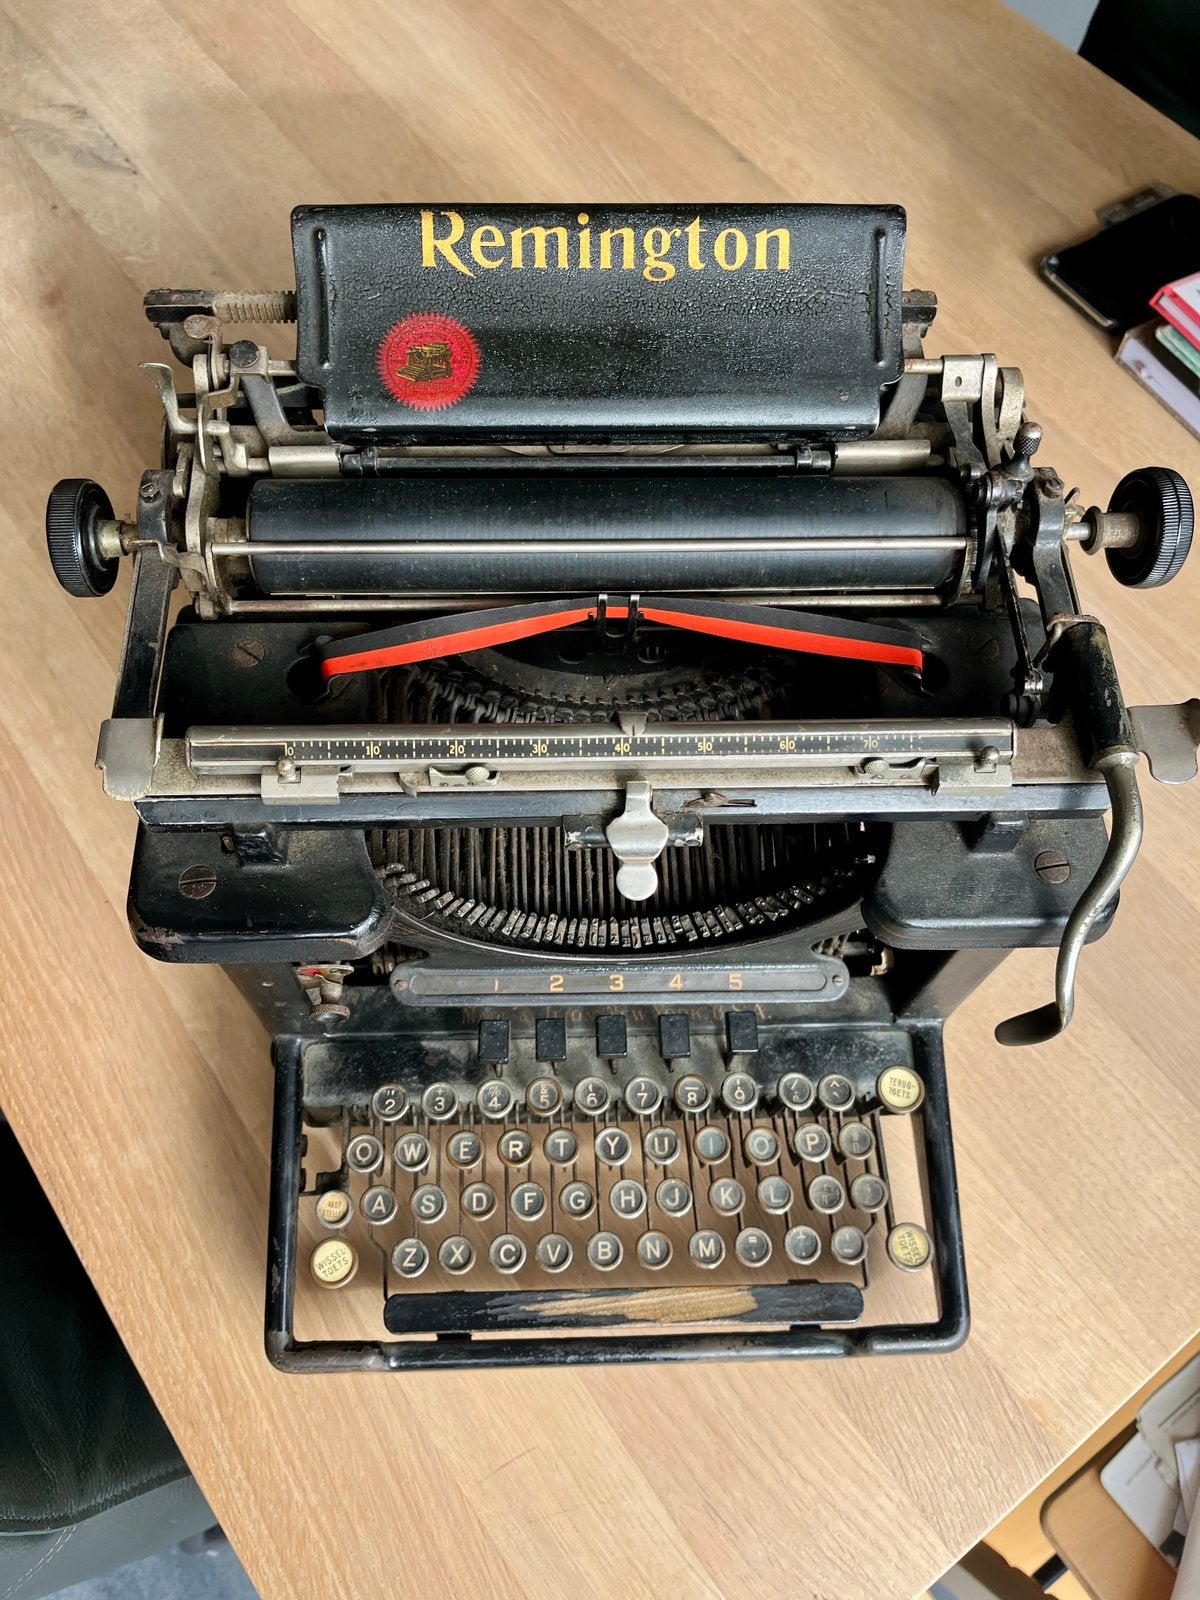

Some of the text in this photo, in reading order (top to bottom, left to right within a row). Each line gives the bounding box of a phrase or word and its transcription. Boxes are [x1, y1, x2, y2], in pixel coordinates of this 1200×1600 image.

[420, 211, 790, 282] Remington
[288, 747, 294, 757] 0
[549, 975, 564, 992] 2
[609, 975, 624, 992] 3
[669, 974, 683, 991] 4
[728, 973, 743, 990] 5
[434, 1097, 444, 1111] 3
[490, 1096, 502, 1110] 4
[539, 1095, 549, 1109] 5
[586, 1093, 597, 1106] 6
[637, 1092, 648, 1105] 7
[355, 1142, 373, 1165] Q
[403, 1143, 421, 1159] W
[459, 1141, 473, 1158] E
[509, 1140, 523, 1157] R
[555, 1139, 569, 1156] T
[605, 1136, 620, 1156] Y
[654, 1136, 668, 1154] U
[753, 1135, 770, 1153] O
[805, 1133, 820, 1150] P
[371, 1185, 782, 1213] A S D F G H J K L
[402, 1239, 715, 1267] Z X C V B N M
[322, 1256, 349, 1278] TOETS
